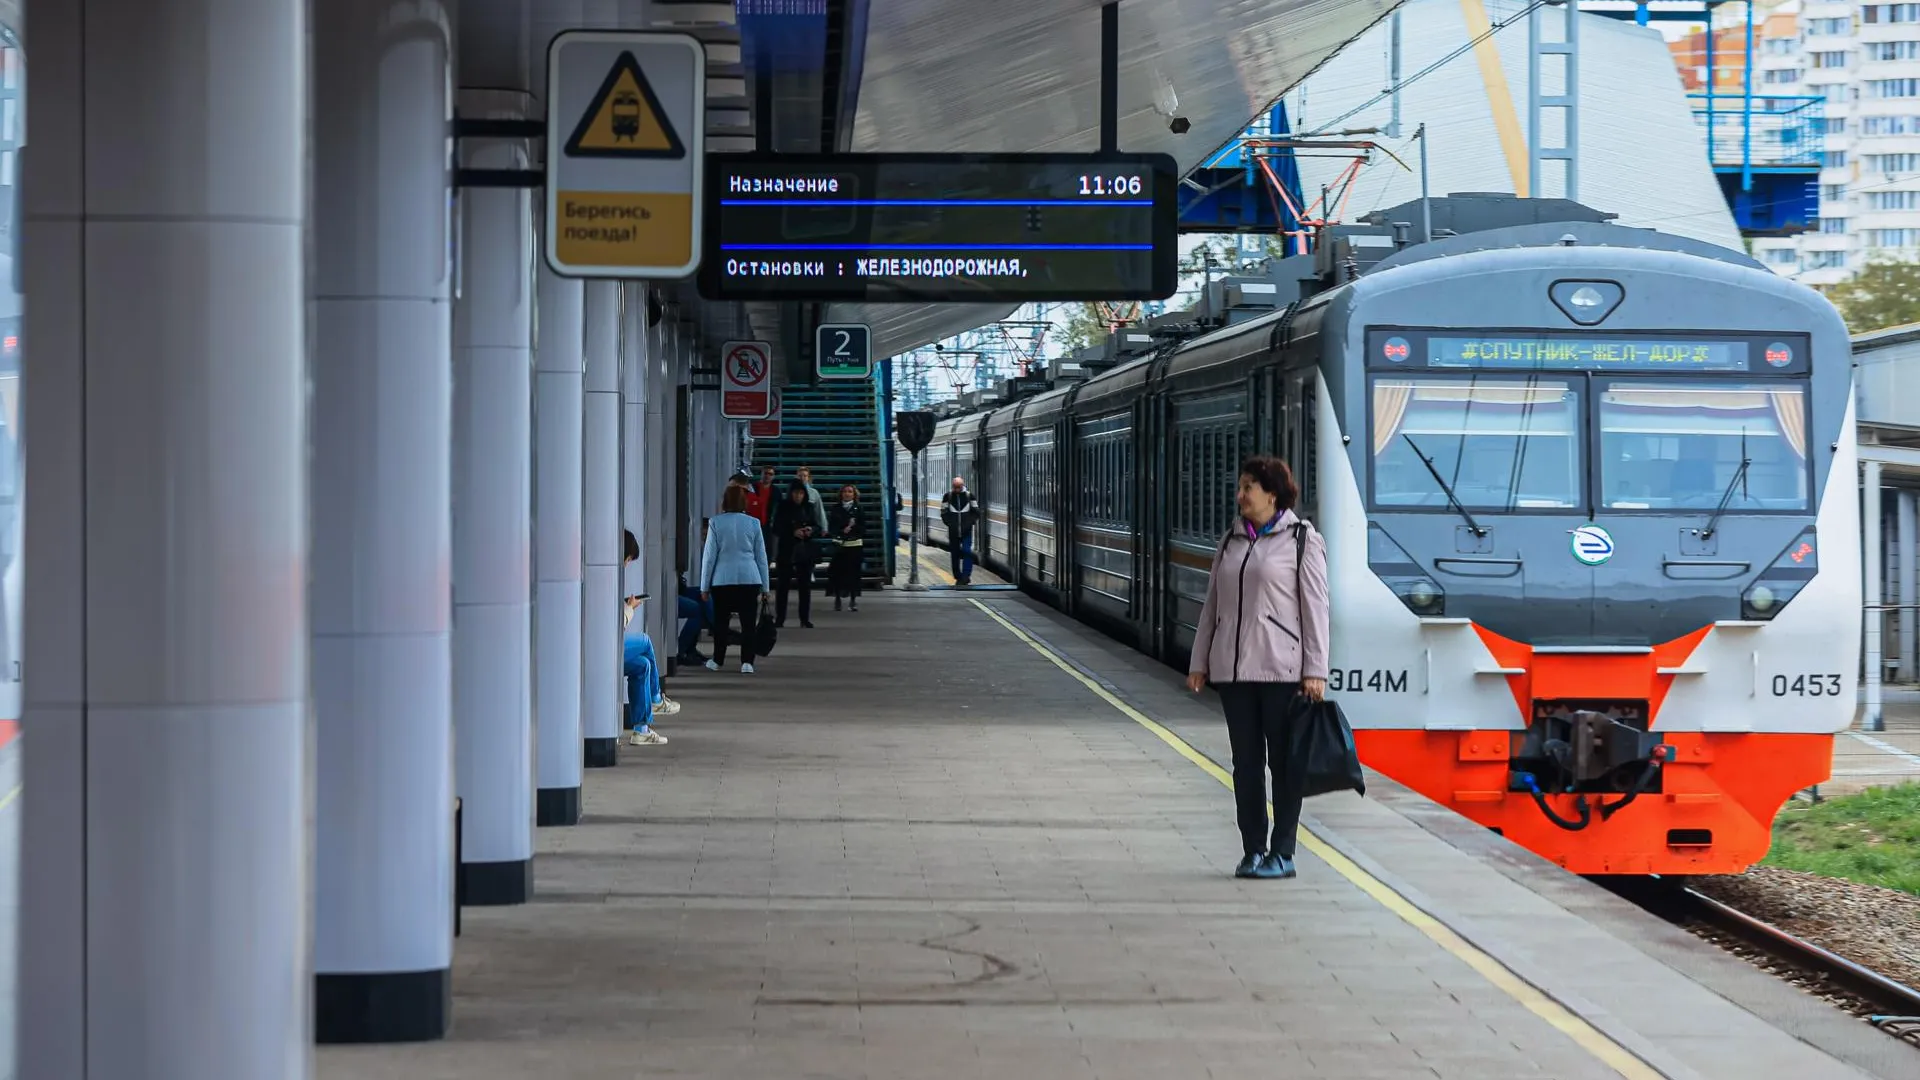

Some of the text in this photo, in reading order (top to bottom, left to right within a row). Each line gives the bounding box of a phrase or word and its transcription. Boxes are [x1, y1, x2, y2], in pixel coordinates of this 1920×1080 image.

[730, 175, 839, 193] Назначение
[1078, 175, 1142, 195] 11:06
[565, 200, 653, 221] Берегись
[564, 224, 638, 244] поезда!
[727, 258, 825, 276] Остановки
[856, 258, 1028, 278] ЖЕЛЕЗНОДОРОЖНАЯ,
[834, 330, 851, 356] 2
[1329, 668, 1408, 693] ЭД4М
[1772, 674, 1842, 697] 0453
